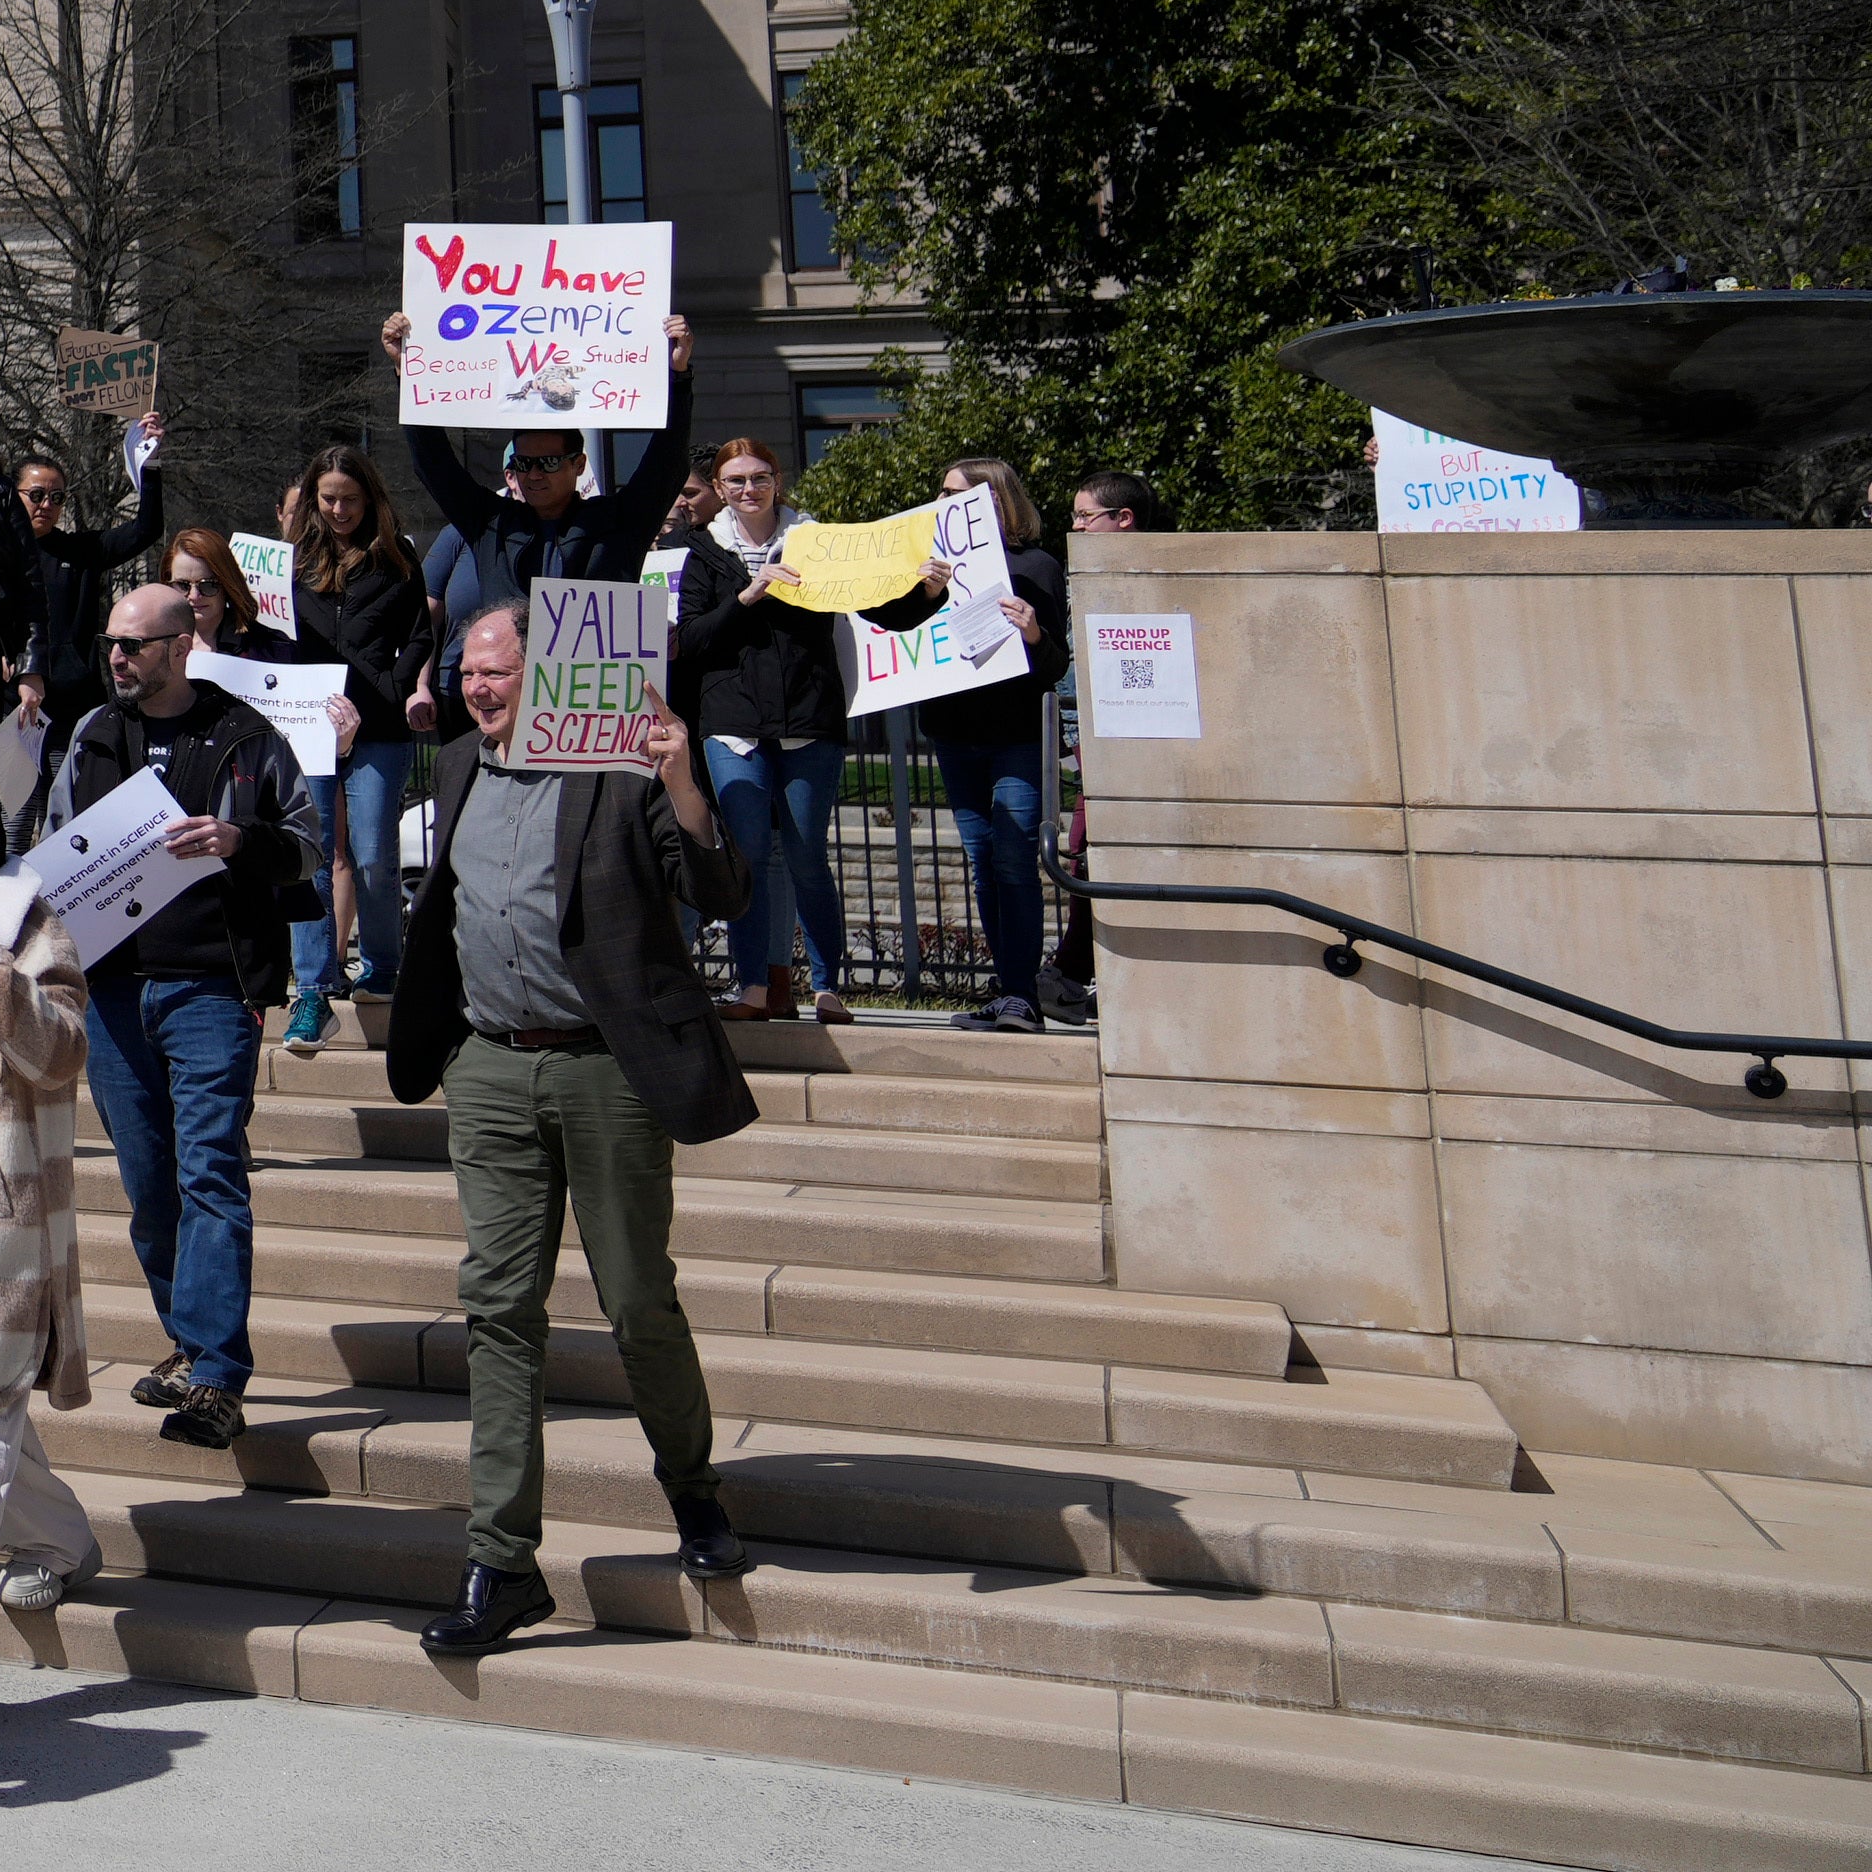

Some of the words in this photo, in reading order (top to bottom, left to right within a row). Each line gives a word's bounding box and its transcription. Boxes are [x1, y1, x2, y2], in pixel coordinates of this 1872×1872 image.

[415, 234, 523, 296] You
[541, 238, 645, 296] have
[60, 341, 111, 363] FUND
[66, 345, 156, 391] FACTS
[406, 345, 498, 377] Because
[506, 339, 570, 379] We
[582, 345, 649, 365] Studied
[66, 391, 95, 405] NOT
[99, 379, 152, 405] FELONS
[413, 382, 492, 406] Lizard
[589, 380, 641, 412] Spit
[1404, 474, 1546, 510] STUPIDITY
[1459, 504, 1484, 518] IS
[807, 525, 906, 563] SCIENCE
[777, 577, 857, 608] CREATES
[863, 571, 918, 603] JOBS
[541, 588, 658, 659] Y'ALL
[1098, 629, 1146, 639] STAND
[1150, 629, 1170, 639] UP
[866, 622, 978, 682] LIVE
[1111, 641, 1172, 651] SCIENCE
[283, 698, 292, 708] in
[531, 662, 645, 713] NEED
[149, 747, 168, 756] FOR
[526, 712, 660, 755] SCIENC
[44, 854, 108, 904] nvestment
[108, 846, 119, 861] in
[119, 809, 169, 850] SCIENCE
[66, 896, 82, 911] an
[148, 839, 162, 853] in
[95, 872, 144, 912] Georgia
